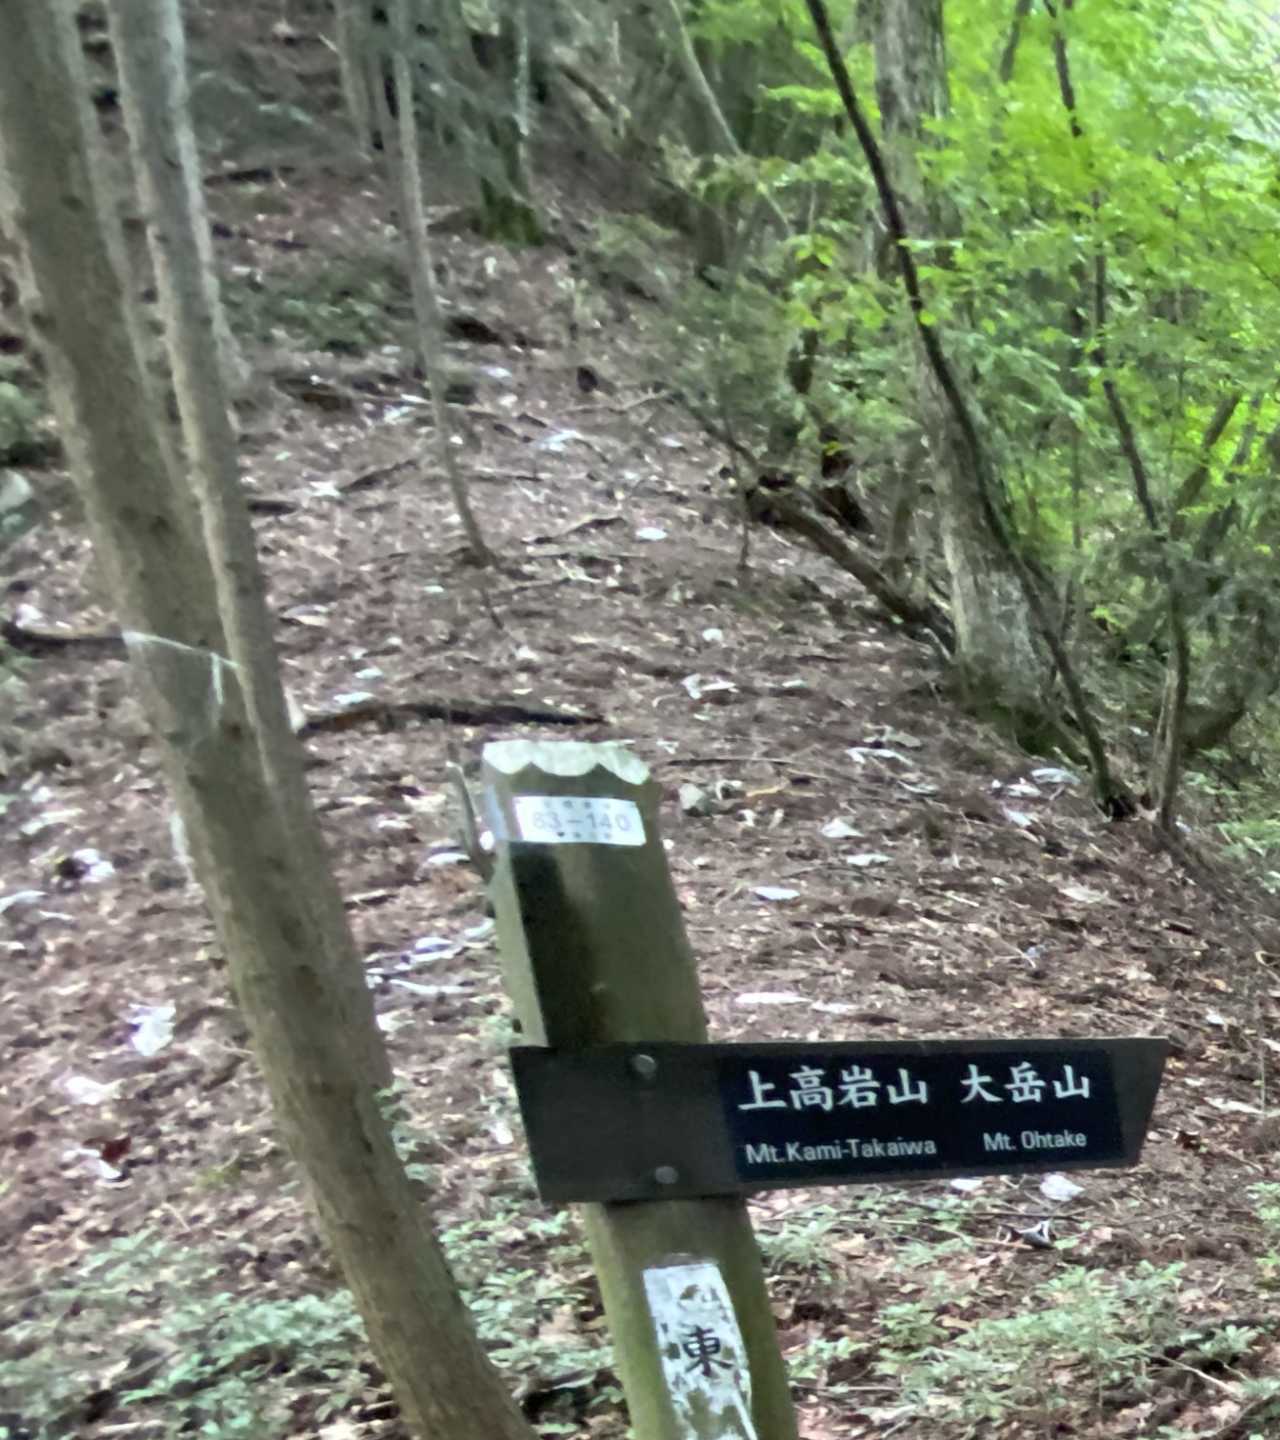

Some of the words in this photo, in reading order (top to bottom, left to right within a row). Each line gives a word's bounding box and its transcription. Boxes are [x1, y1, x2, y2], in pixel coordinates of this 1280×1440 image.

[738, 1064, 929, 1112] 上高岩山
[960, 1061, 1092, 1104] 大岳山
[984, 1132, 1017, 1152] Mt.
[1021, 1130, 1088, 1150] Ohtake
